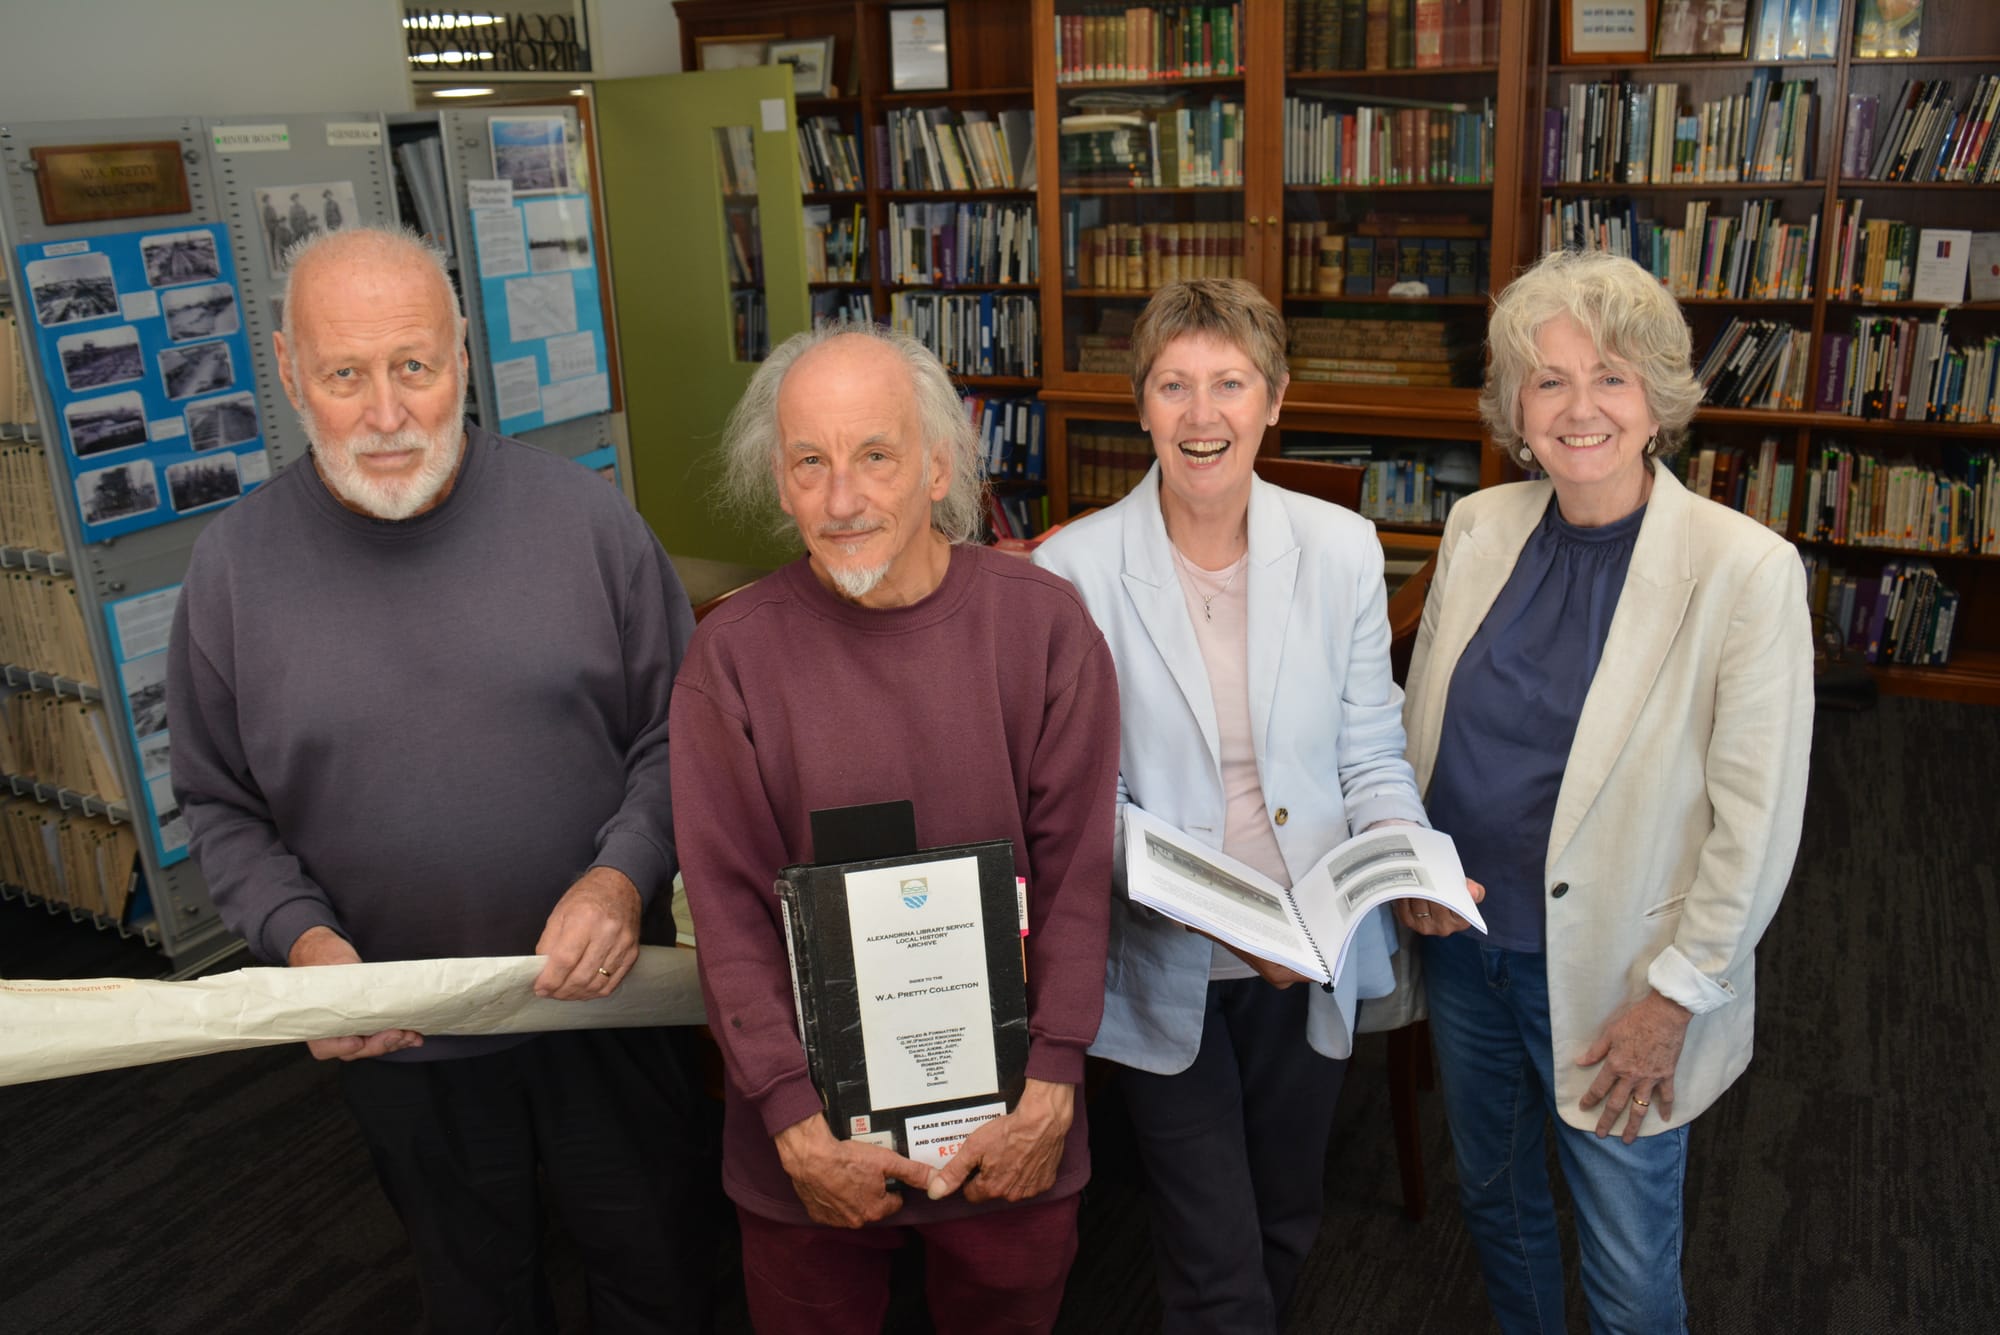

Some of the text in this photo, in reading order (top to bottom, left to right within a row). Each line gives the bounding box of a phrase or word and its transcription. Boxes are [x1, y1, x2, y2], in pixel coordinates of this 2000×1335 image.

[866, 922, 975, 942] ALEXANDRINA LIBRARY SERVICE
[895, 932, 948, 944] LOCAL HISTORY
[907, 940, 938, 949] ARCHIVE
[875, 981, 979, 1001] W.A. PRETTY COLLECTION
[913, 1123, 939, 1131] PLEASE
[941, 1119, 964, 1127] ENTER
[915, 1138, 930, 1146] AND
